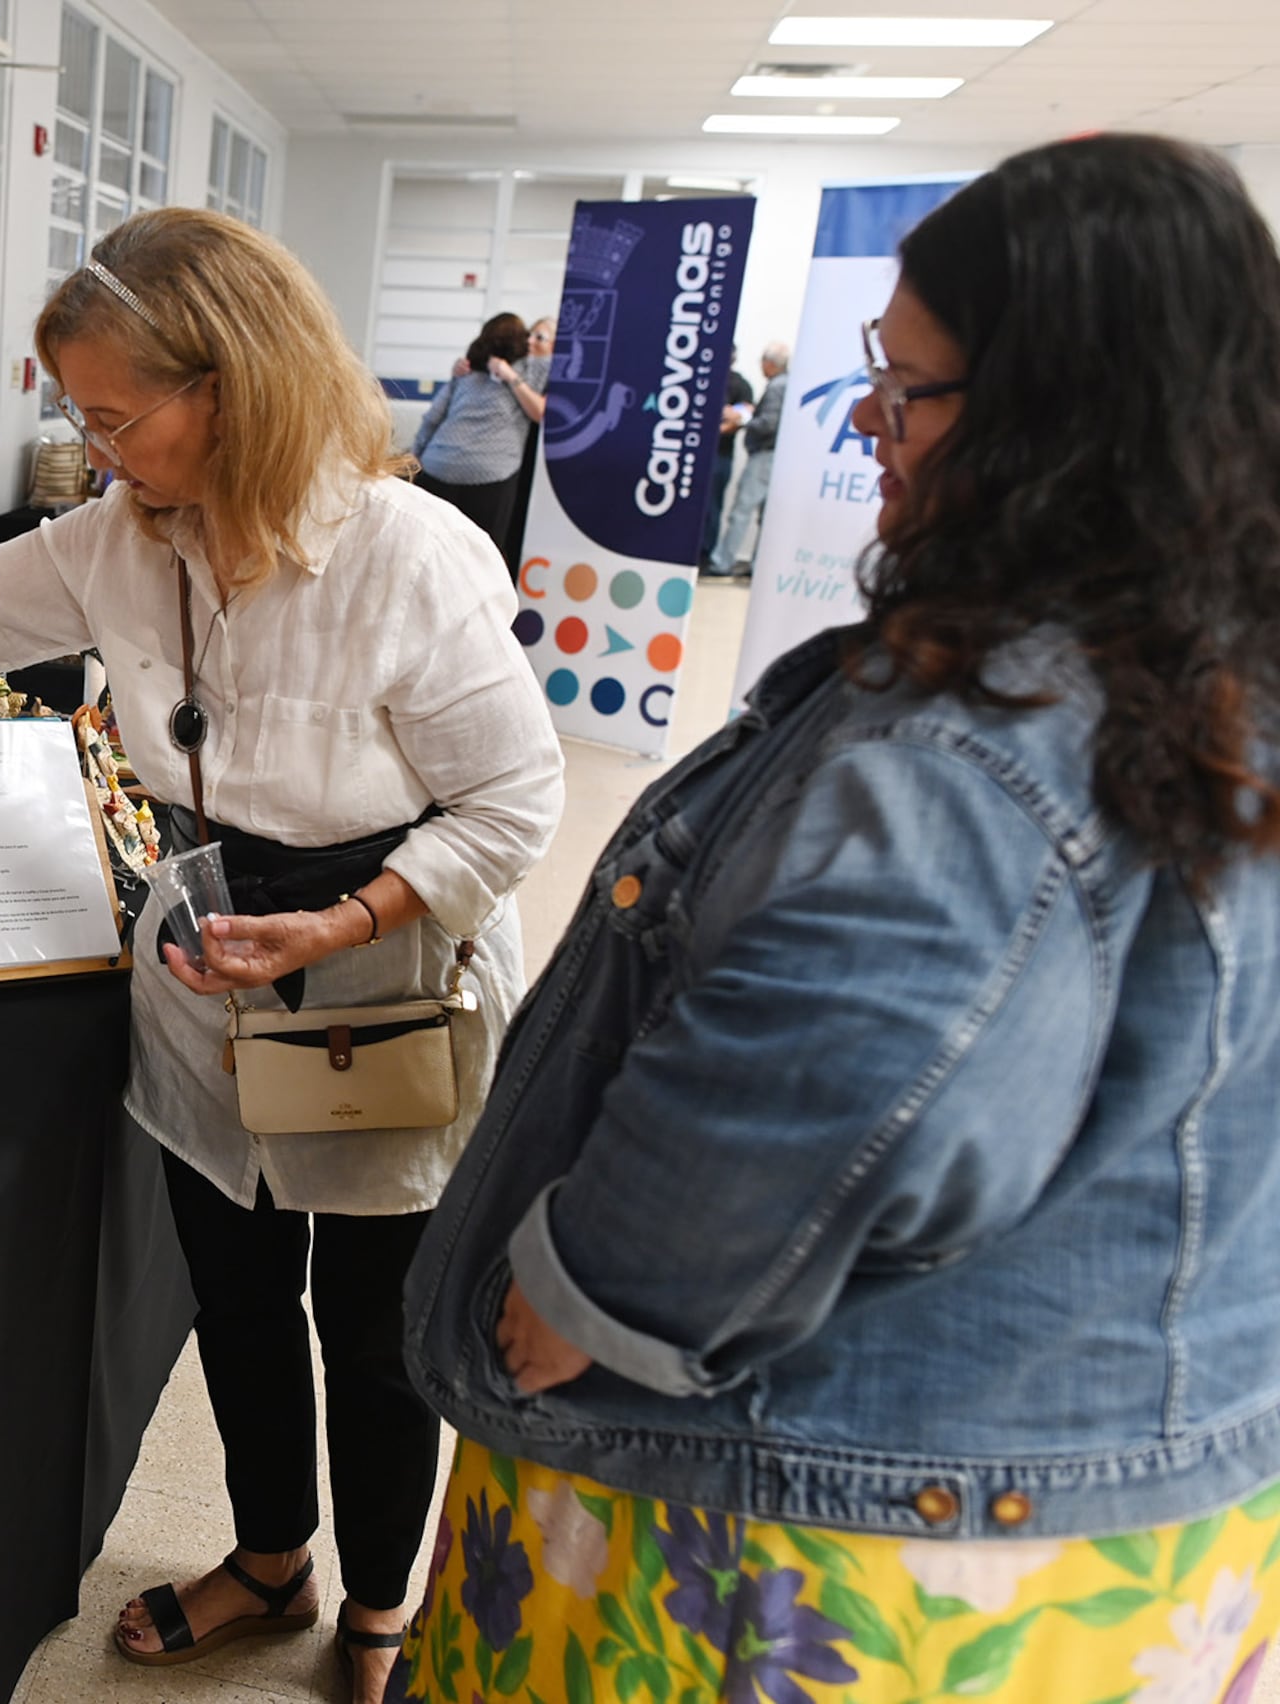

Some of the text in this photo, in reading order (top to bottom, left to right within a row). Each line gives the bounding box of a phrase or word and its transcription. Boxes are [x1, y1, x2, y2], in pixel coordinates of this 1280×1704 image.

[684, 224, 733, 448] Directo Contigo
[775, 570, 846, 601] vivir
